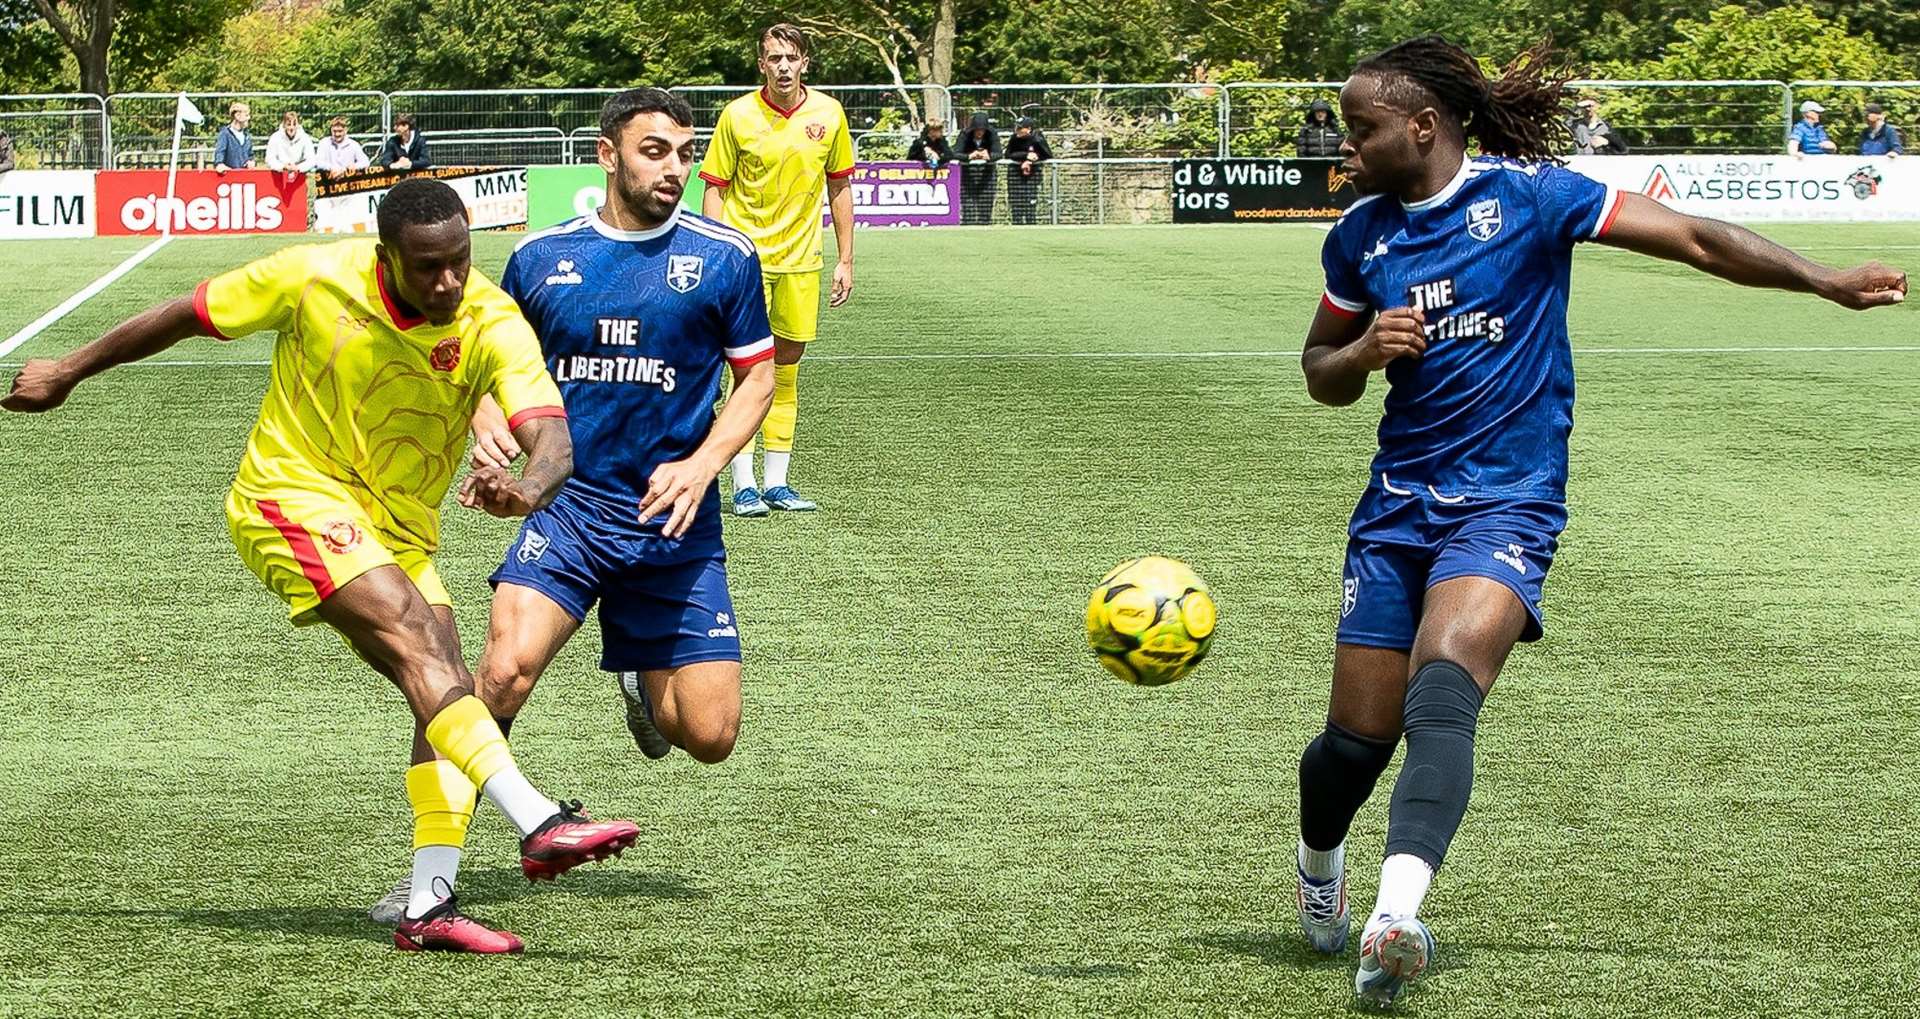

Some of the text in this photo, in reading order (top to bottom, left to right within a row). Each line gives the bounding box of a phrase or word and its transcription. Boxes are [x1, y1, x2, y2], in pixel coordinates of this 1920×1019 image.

[1198, 164, 1216, 185] &
[1224, 163, 1302, 185] White
[1676, 162, 1774, 176] ALL ABOUT
[877, 183, 949, 205] EXTRA
[1686, 179, 1840, 200] ASBESTOS
[1410, 279, 1454, 312] THE
[598, 319, 639, 346] THE
[556, 355, 676, 392] LIBERTINES
